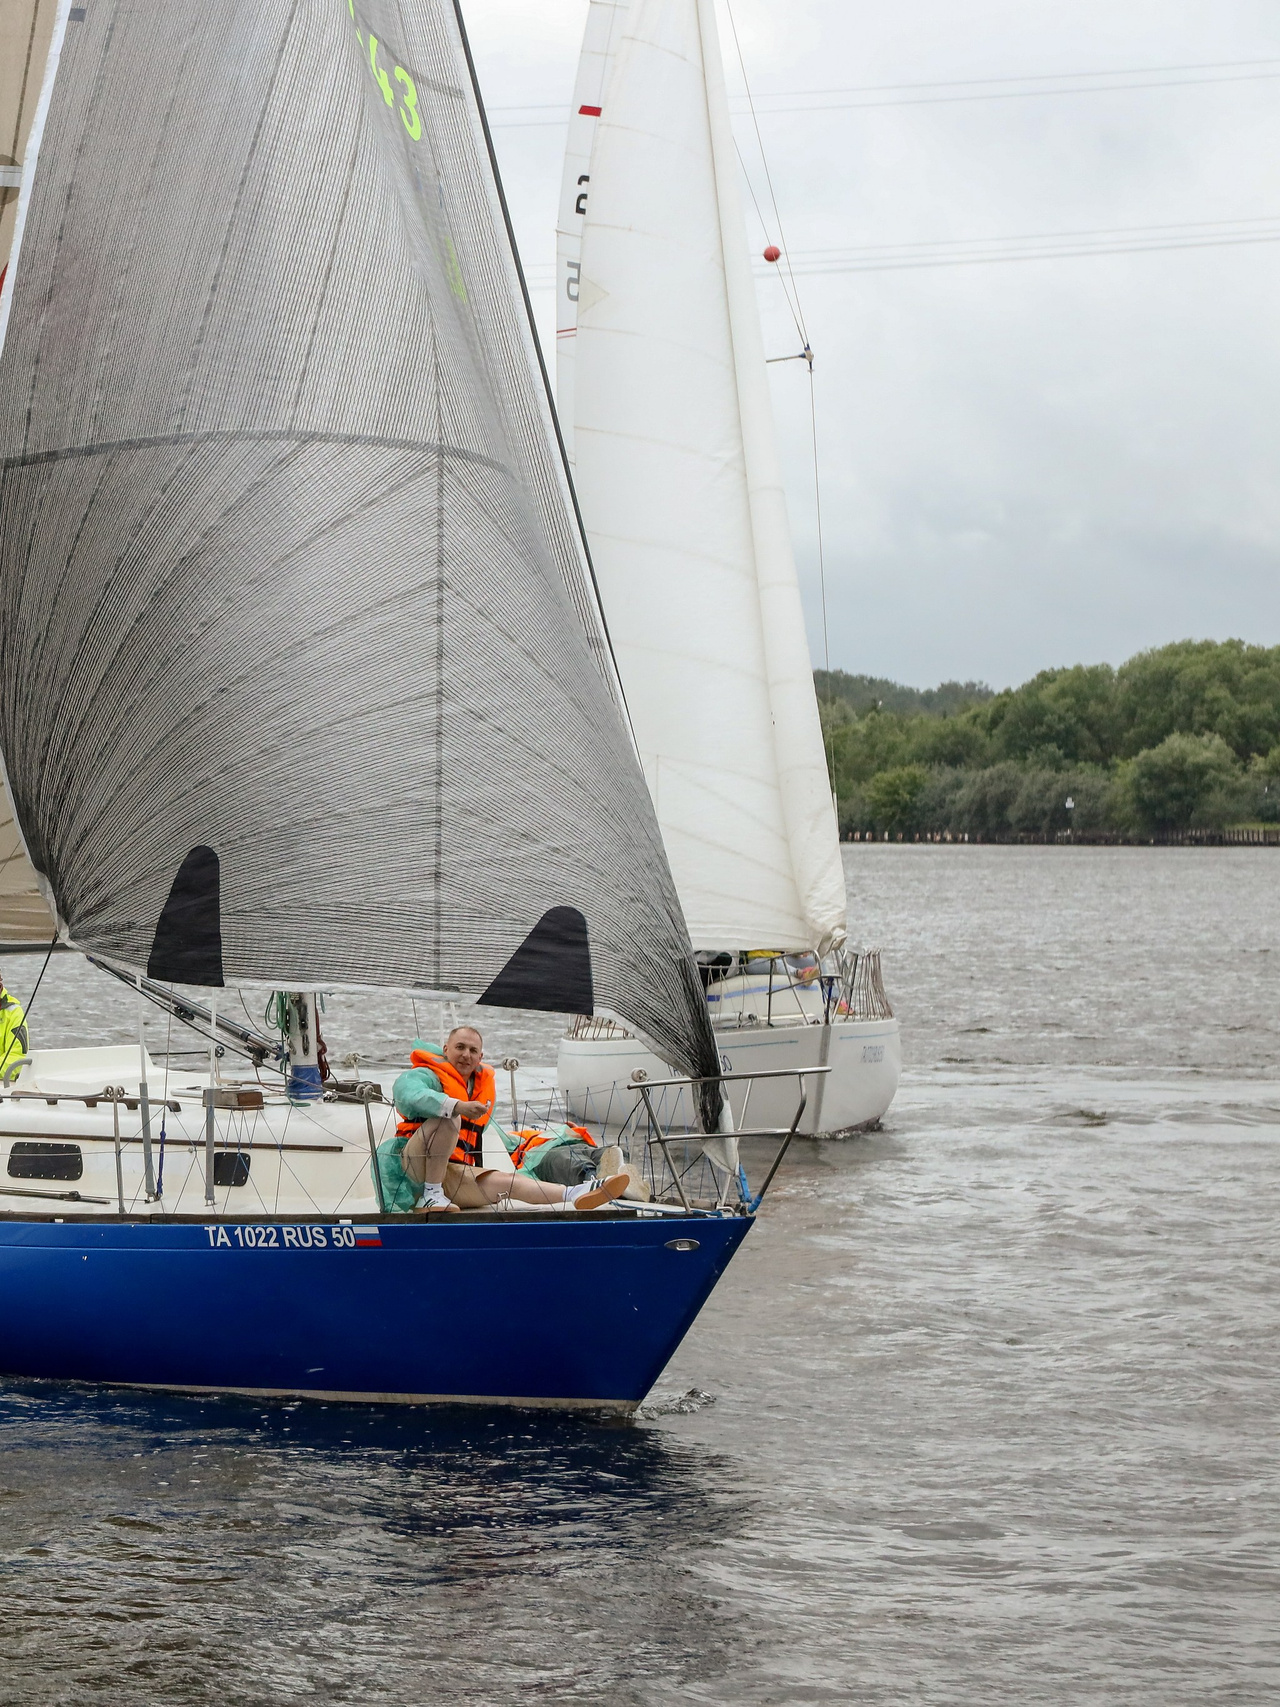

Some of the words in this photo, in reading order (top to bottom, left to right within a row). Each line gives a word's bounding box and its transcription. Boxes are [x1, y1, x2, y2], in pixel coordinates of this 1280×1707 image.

[204, 1226, 232, 1247] TA
[234, 1226, 280, 1248] 1022
[282, 1226, 328, 1248] RUS
[331, 1226, 356, 1248] 50
